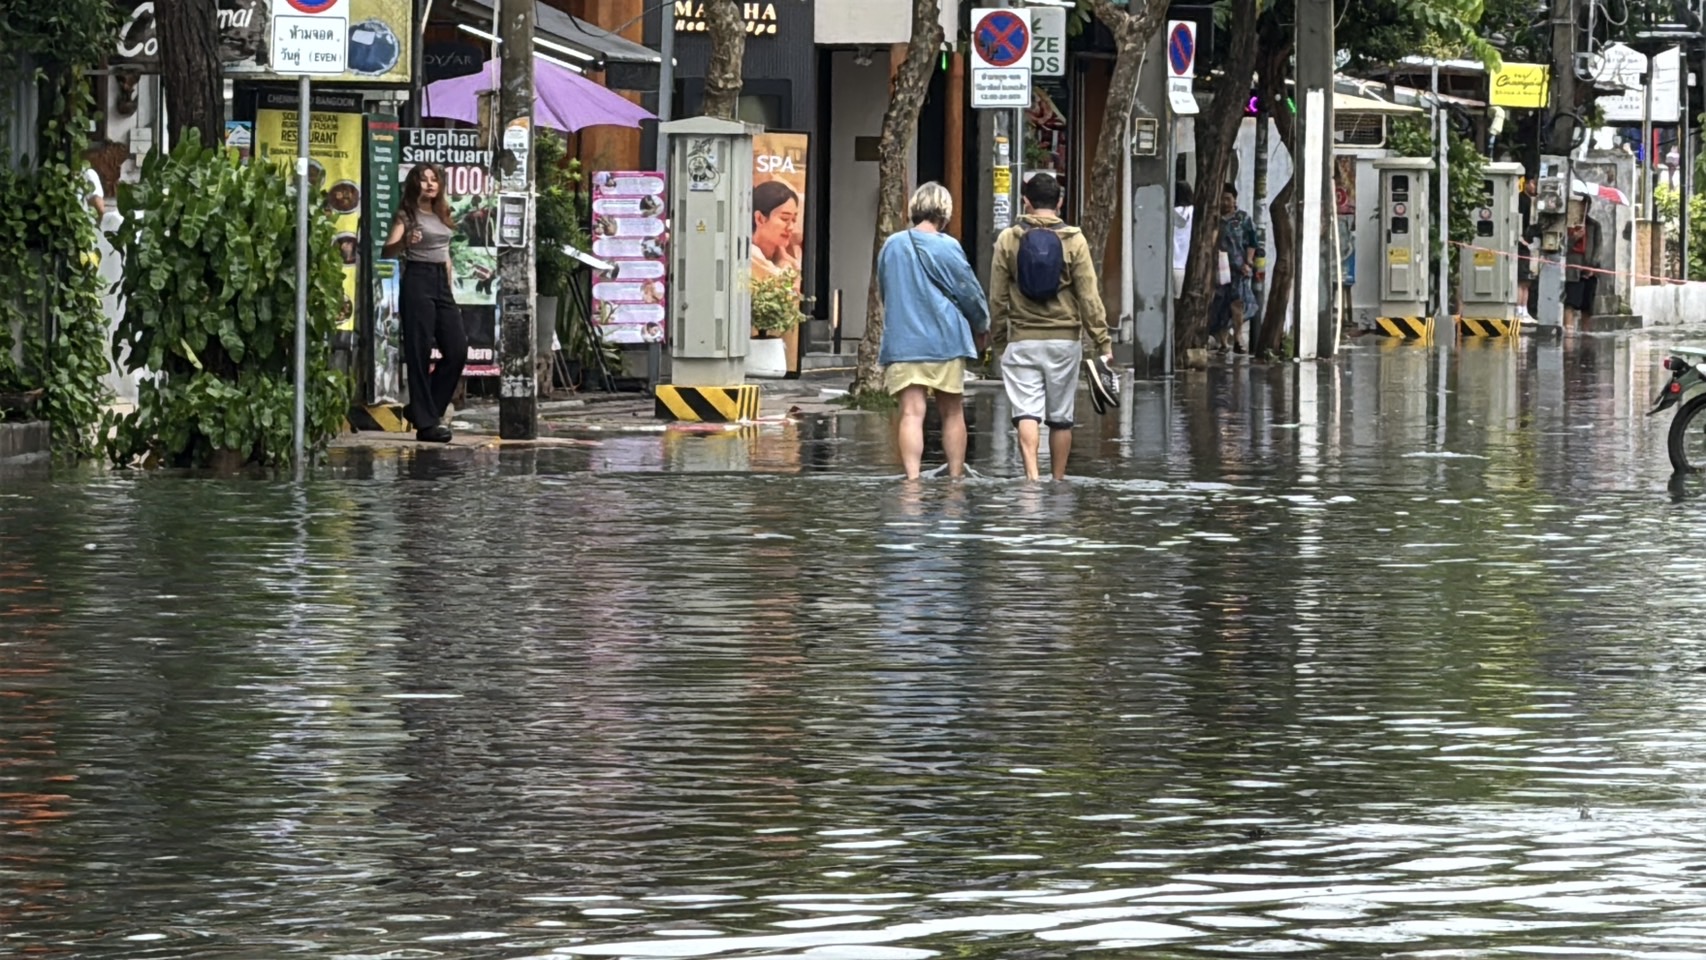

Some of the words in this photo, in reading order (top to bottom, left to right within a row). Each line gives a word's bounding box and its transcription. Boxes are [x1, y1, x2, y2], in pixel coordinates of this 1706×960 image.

[1033, 37, 1060, 53] ZE
[410, 129, 480, 149] Elephan
[403, 146, 494, 167] Sanctuary
[756, 155, 796, 173] SPA
